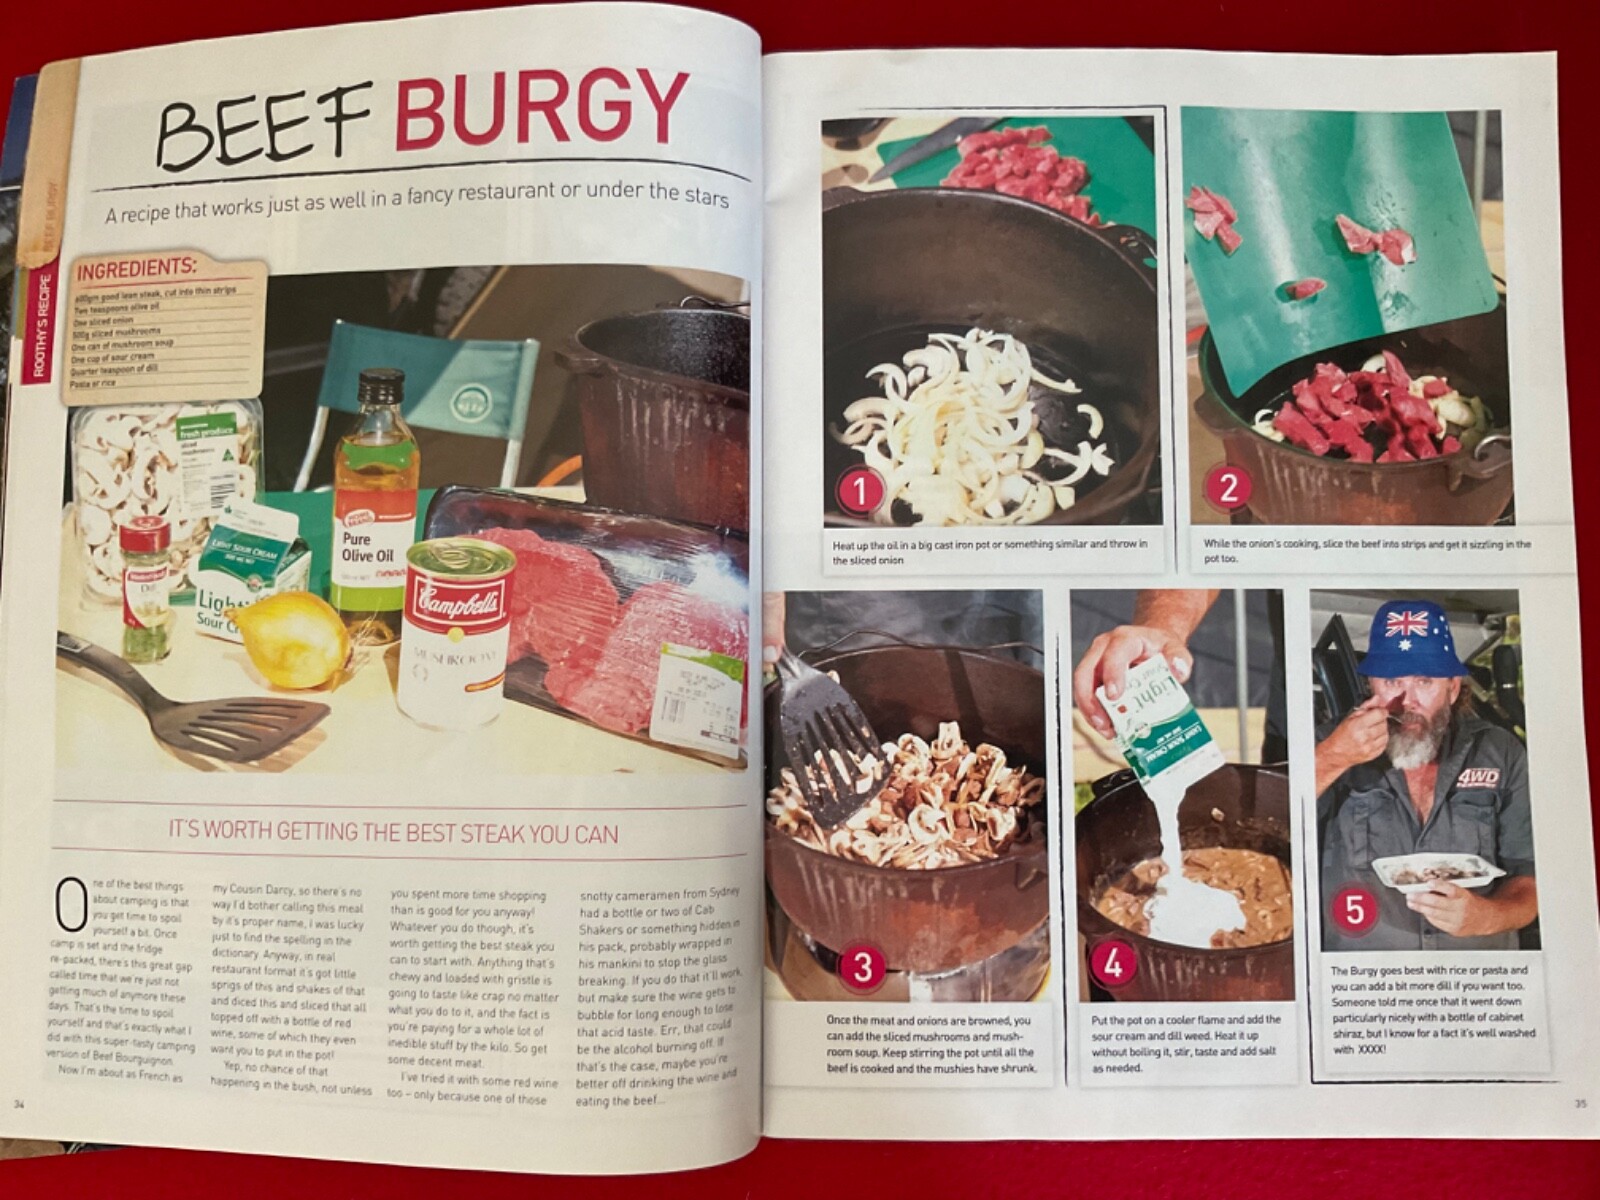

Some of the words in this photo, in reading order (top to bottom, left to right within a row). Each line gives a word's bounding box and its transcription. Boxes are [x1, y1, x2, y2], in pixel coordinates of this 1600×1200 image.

[156, 81, 373, 172] BEEF
[397, 68, 690, 152] BURGY
[104, 207, 117, 224] A
[121, 204, 170, 225] recipe
[175, 201, 207, 219] that
[212, 197, 264, 216] works
[266, 195, 299, 218] just
[304, 197, 325, 211] as
[329, 191, 366, 209] well
[371, 190, 386, 207] in
[391, 192, 402, 206] a
[407, 186, 456, 207] fancy
[462, 181, 555, 201] restaurant
[560, 184, 582, 198] or
[586, 179, 644, 198] under
[649, 181, 680, 201] the
[685, 187, 729, 209] stars
[78, 257, 197, 280] INGREDIENTS:
[38, 274, 52, 316] RECIPE
[34, 319, 48, 377] ROOTHY'S
[70, 343, 86, 352] One
[86, 343, 100, 351] can
[102, 341, 110, 350] of
[110, 340, 153, 349] mushroom
[154, 339, 174, 348] soup
[70, 355, 86, 364] One
[86, 356, 100, 364] cup
[101, 353, 110, 362] of
[110, 354, 128, 362] sour
[129, 352, 155, 361] cream
[853, 478, 866, 505] 1
[1220, 474, 1238, 502] 2
[343, 532, 371, 546] Pure
[832, 541, 855, 551] Heat
[856, 542, 869, 552] up
[870, 541, 885, 550] the
[886, 541, 899, 550] oil
[899, 541, 909, 550] in
[910, 542, 916, 550] a
[918, 540, 932, 552] big
[934, 541, 953, 550] cast
[954, 541, 974, 549] iron
[975, 540, 990, 551] pot
[991, 541, 1002, 549] or
[1004, 539, 1054, 551] something
[1055, 539, 1088, 548] similar
[1090, 539, 1108, 548] and
[1109, 539, 1137, 548] throw
[1138, 539, 1148, 548] in
[1203, 538, 1230, 548] While
[1231, 539, 1247, 548] the
[1248, 538, 1282, 548] onion's
[1282, 539, 1321, 550] cooking,
[1322, 539, 1344, 548] slice
[1344, 539, 1360, 548] the
[1361, 539, 1381, 548] beef
[1382, 540, 1400, 548] into
[1400, 540, 1427, 550] strips
[1428, 540, 1444, 549] and
[1445, 541, 1460, 551] get
[1461, 541, 1467, 549] it
[1469, 540, 1504, 551] sizzling
[1515, 540, 1532, 548] the
[233, 544, 252, 554] SOUR
[252, 548, 278, 560] CREAM
[342, 548, 374, 562] Olive
[376, 550, 394, 562] Oil
[832, 556, 848, 565] the
[850, 555, 877, 565] sliced
[878, 557, 904, 565] onion
[196, 612, 223, 629] Sour
[1458, 768, 1500, 784] 4WD
[169, 818, 200, 838] IT'S
[203, 819, 272, 839] WORTH
[277, 820, 358, 841] GETTING
[362, 822, 401, 842] THE
[406, 822, 457, 843] BEST
[461, 823, 525, 844] STEAK
[529, 824, 569, 844] YOU
[575, 824, 618, 844] CAN
[390, 889, 409, 900] you
[411, 889, 440, 901] spent
[442, 891, 469, 899] more
[472, 890, 496, 900] time
[498, 890, 546, 904] shopping
[55, 876, 88, 933] O
[580, 907, 600, 918] had
[602, 910, 609, 918] a
[612, 907, 643, 918] bottle
[645, 908, 658, 917] or
[660, 907, 680, 917] two
[682, 904, 692, 916] of
[694, 904, 714, 915] Cab
[1346, 895, 1364, 924] 5
[853, 952, 872, 982] 3
[1104, 948, 1123, 978] 4
[1330, 965, 1348, 976] The
[1350, 965, 1378, 978] Burgy
[1379, 967, 1402, 978] goes
[1404, 965, 1424, 975] best
[1426, 965, 1447, 975] with
[1448, 967, 1468, 975] rice
[1469, 967, 1480, 975] or
[1482, 966, 1508, 977] pasta
[1510, 965, 1528, 975] and
[1091, 1015, 1108, 1026] Put
[1109, 1015, 1125, 1025] the
[1126, 1016, 1142, 1027] pot
[1144, 1017, 1156, 1025] on
[1158, 1017, 1164, 1025] a
[1166, 1015, 1196, 1025] cooler
[1197, 1015, 1226, 1025] flame
[1226, 1015, 1245, 1025] and
[1246, 1014, 1264, 1024] add
[1265, 1014, 1282, 1024] the
[1333, 1045, 1354, 1054] with
[1358, 1044, 1386, 1054] XXXX!
[826, 1062, 848, 1073] beef
[850, 1063, 859, 1073] is
[860, 1064, 894, 1074] cooked
[896, 1064, 914, 1074] and
[916, 1064, 932, 1074] the
[933, 1064, 975, 1074] mushies
[976, 1064, 999, 1074] have
[1000, 1063, 1036, 1073] shrunk.
[14, 1100, 24, 1109] 34
[1576, 1099, 1588, 1110] 35
